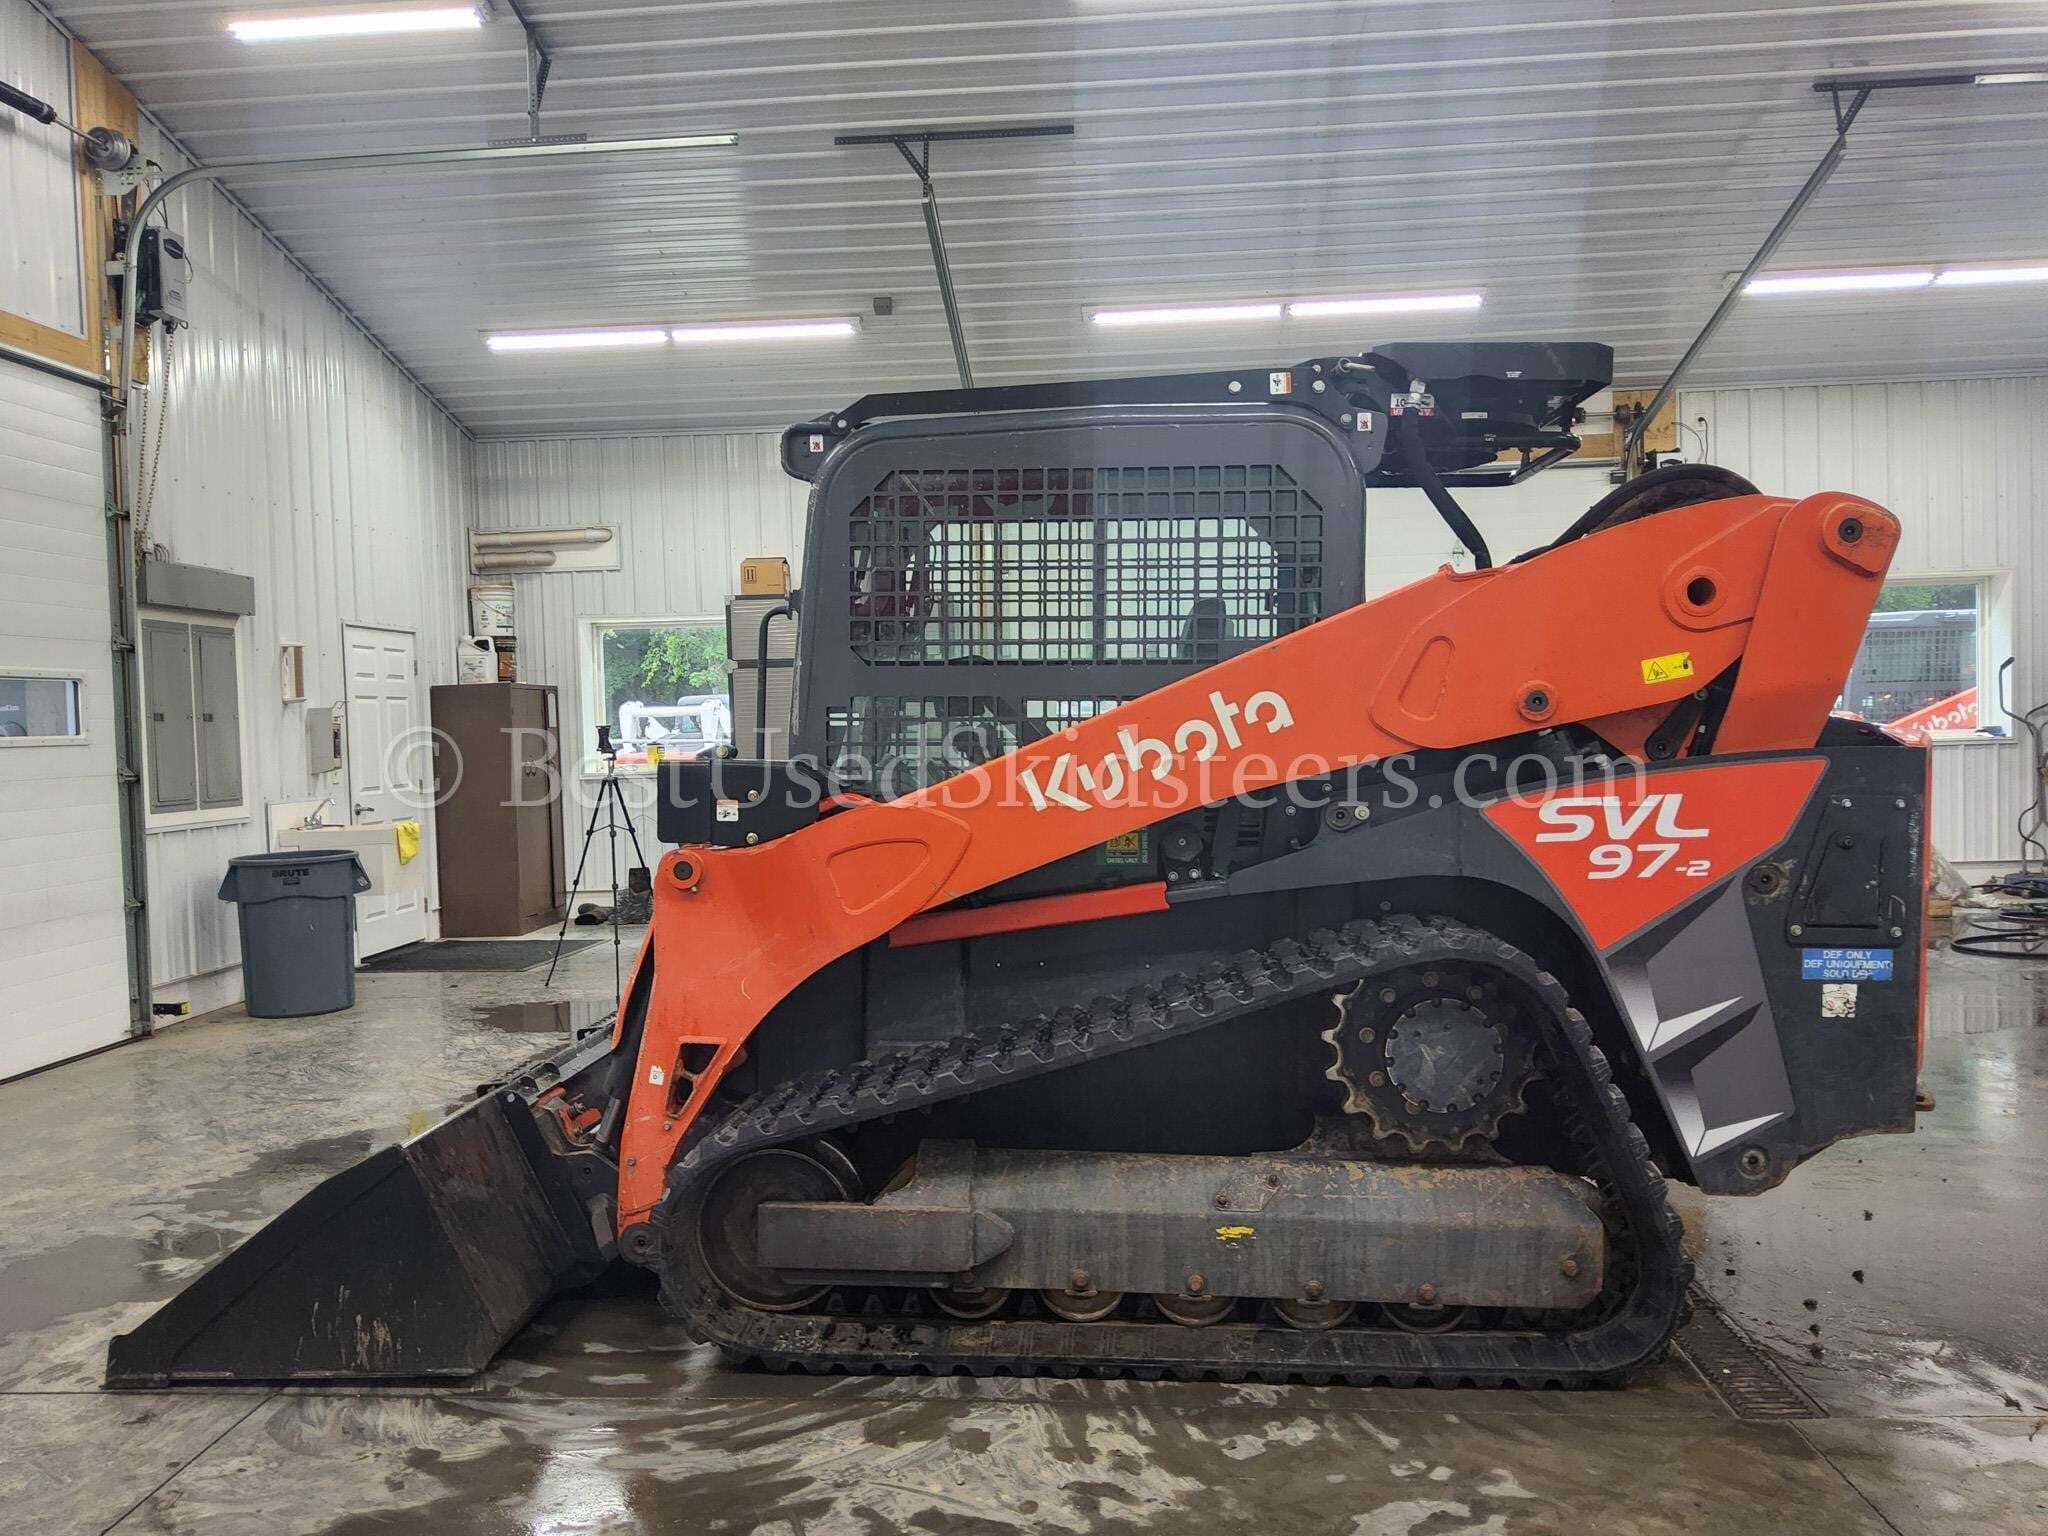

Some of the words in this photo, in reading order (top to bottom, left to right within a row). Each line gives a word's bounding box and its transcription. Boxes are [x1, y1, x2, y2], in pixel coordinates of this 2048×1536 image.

[1021, 690, 1295, 812] Kubota
[1535, 793, 1711, 843] SVL
[271, 867, 310, 879] BRUTE
[1587, 843, 1712, 880] 97-2
[1803, 960, 1824, 969] DEF
[1823, 950, 1843, 960] DEF
[1846, 950, 1873, 960] ONLY
